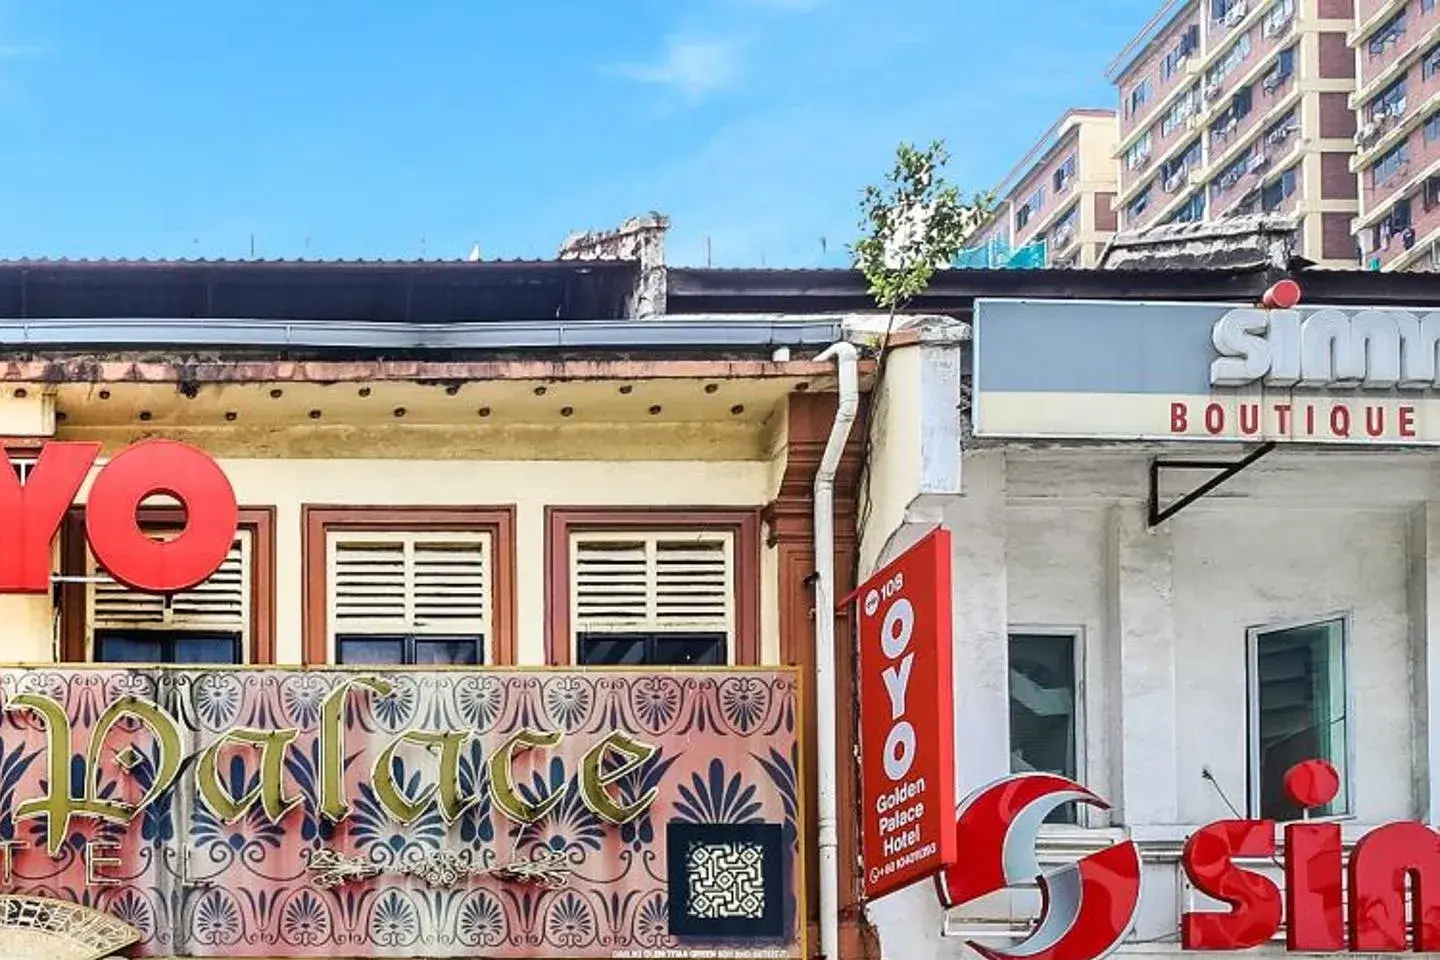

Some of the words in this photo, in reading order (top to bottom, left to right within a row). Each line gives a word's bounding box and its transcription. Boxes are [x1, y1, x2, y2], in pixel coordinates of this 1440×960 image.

[1170, 402, 1416, 437] BOUTIQUE
[879, 598, 916, 781] OYO
[4, 677, 658, 857] Palace
[876, 777, 926, 814] Golden
[879, 801, 925, 836] Palace
[883, 823, 920, 857] Hotel
